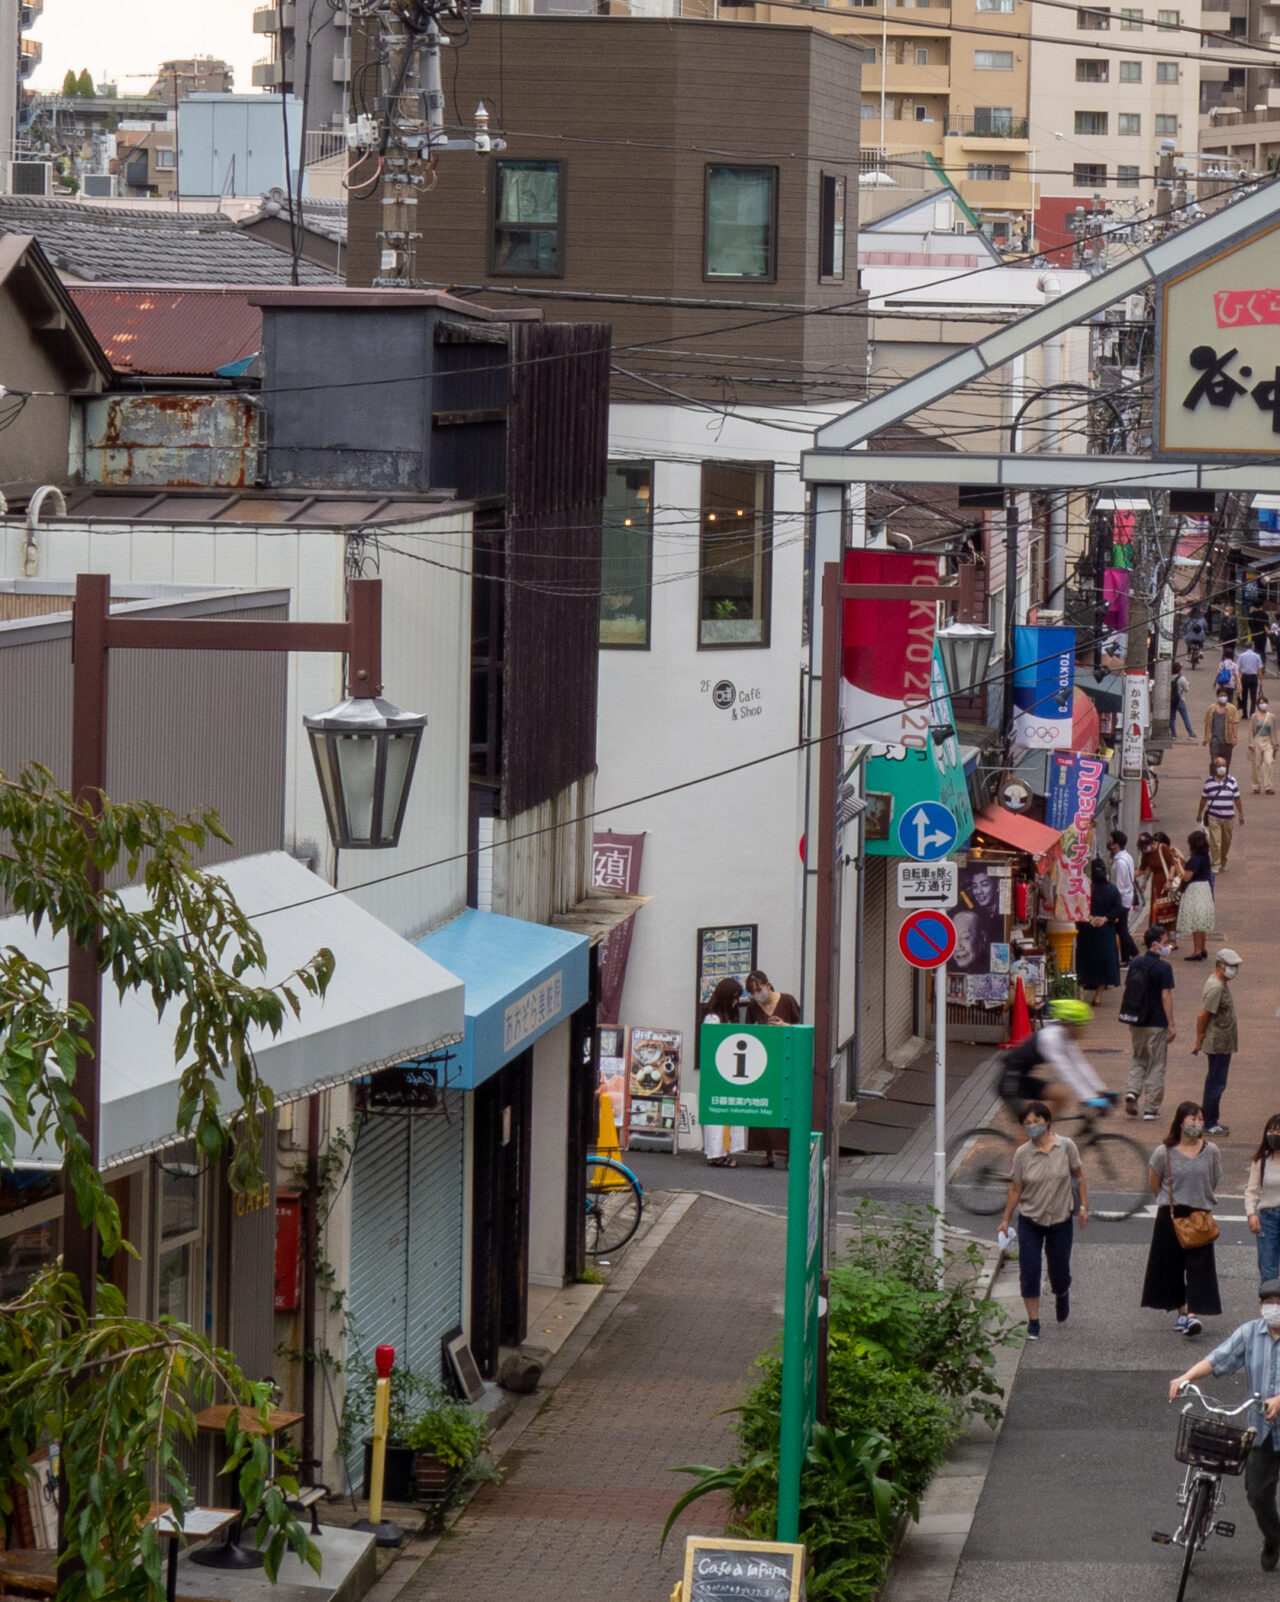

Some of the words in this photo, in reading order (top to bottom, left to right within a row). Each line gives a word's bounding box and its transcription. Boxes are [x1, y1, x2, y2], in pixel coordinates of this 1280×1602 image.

[1059, 653, 1070, 688] TOKYO
[700, 680, 711, 692] 2F
[739, 688, 761, 703] Café
[901, 670, 931, 750] 2020
[1130, 688, 1141, 720] かき氷
[732, 708, 738, 721] &
[740, 706, 762, 719] Shop
[902, 867, 952, 881] 自転車を除く
[902, 880, 952, 892] 一方通行
[711, 1096, 769, 1107] 日暮里案内地図
[698, 1558, 732, 1576] Café
